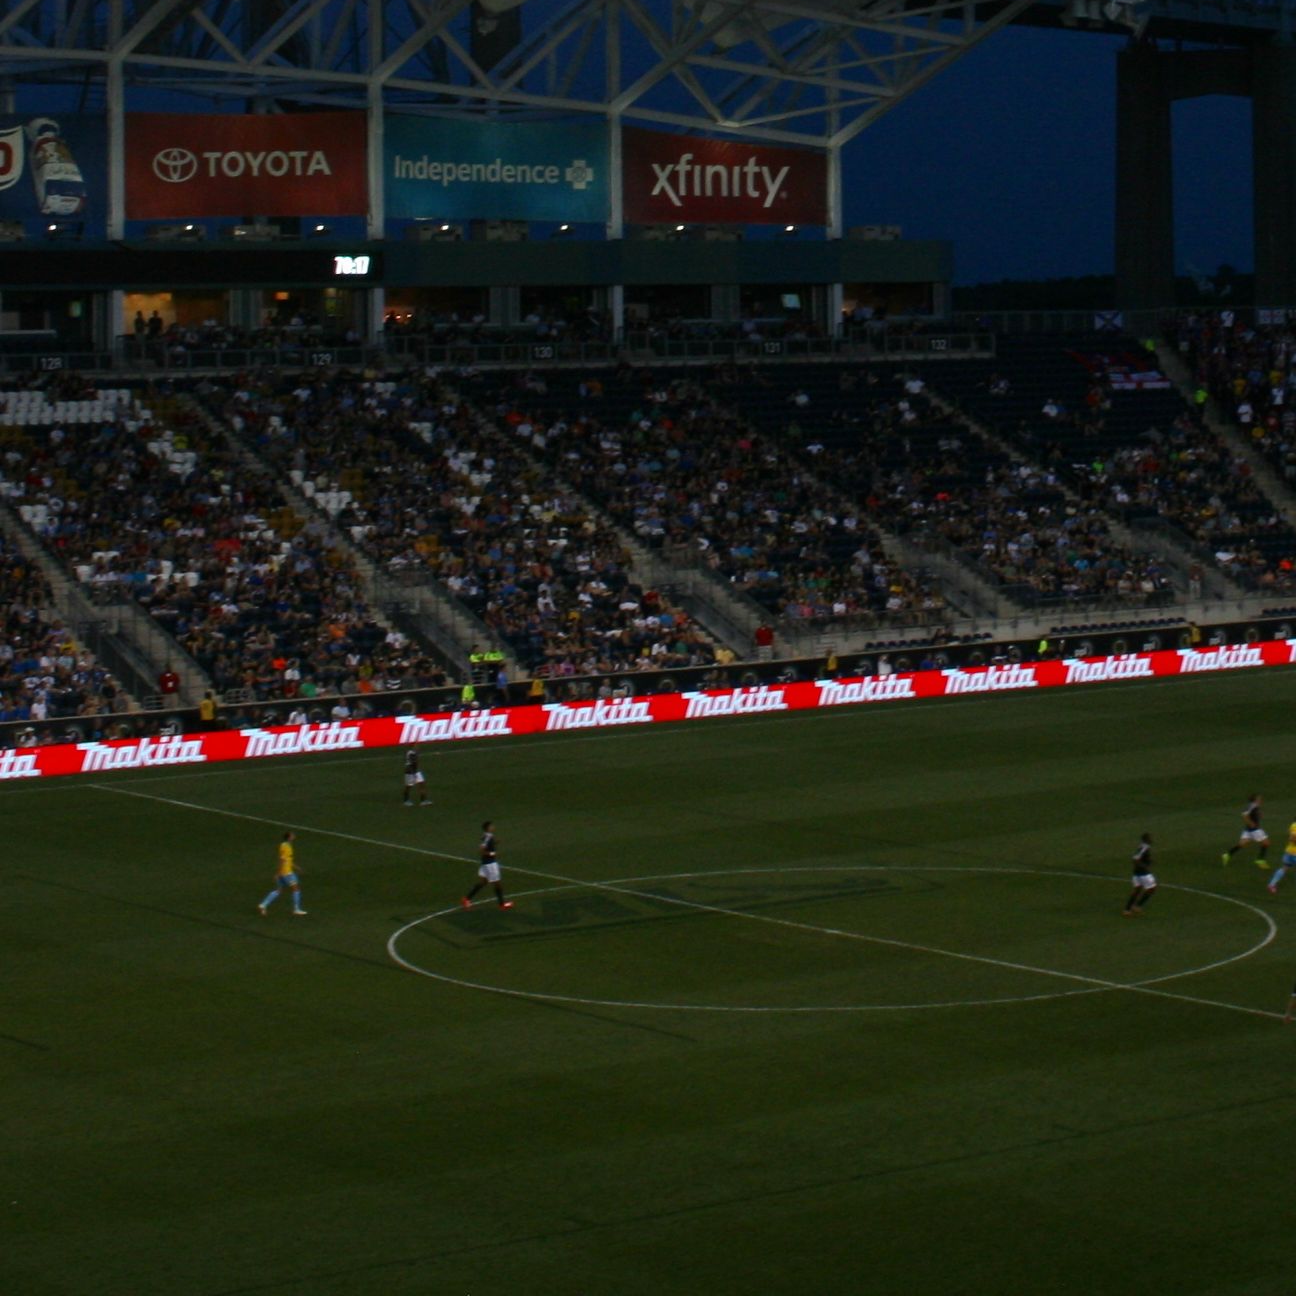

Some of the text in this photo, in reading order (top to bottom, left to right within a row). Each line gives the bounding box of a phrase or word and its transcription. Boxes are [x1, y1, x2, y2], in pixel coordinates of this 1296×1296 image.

[203, 150, 332, 177] TOYOTA
[394, 155, 560, 187] Independence
[651, 153, 790, 208] xfinity
[1063, 654, 1153, 683] Makita
[1177, 644, 1264, 672] Makita
[815, 673, 915, 705] Makita
[942, 664, 1037, 693] Makita
[542, 697, 652, 730] Makita
[682, 686, 787, 717] Makita
[240, 721, 363, 757] Makita
[396, 709, 511, 743] Makita
[77, 735, 206, 771] Makita
